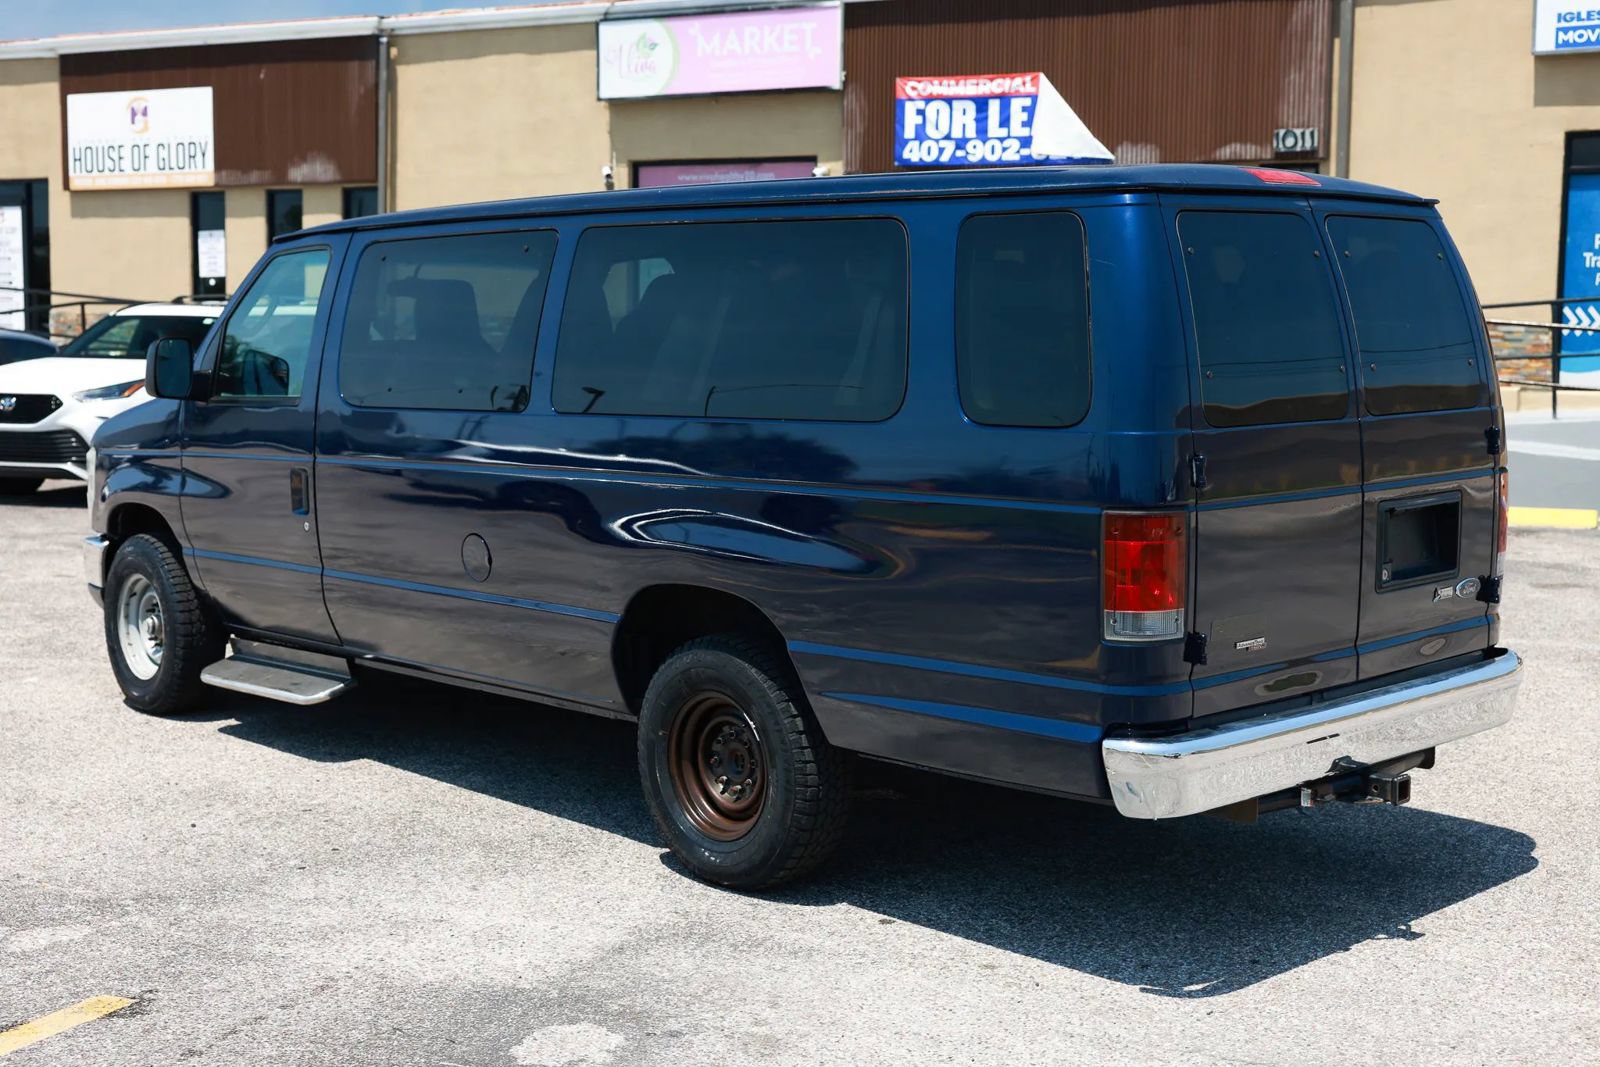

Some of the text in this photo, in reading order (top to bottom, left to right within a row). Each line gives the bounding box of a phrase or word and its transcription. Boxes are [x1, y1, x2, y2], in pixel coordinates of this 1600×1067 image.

[696, 21, 818, 56] MARKET
[904, 76, 1036, 96] COMMERCIAL
[904, 98, 977, 140] FOR
[902, 136, 1080, 163] 407-902-
[1275, 129, 1315, 150] 1011
[73, 140, 209, 174] HOUSE OF GLORY
